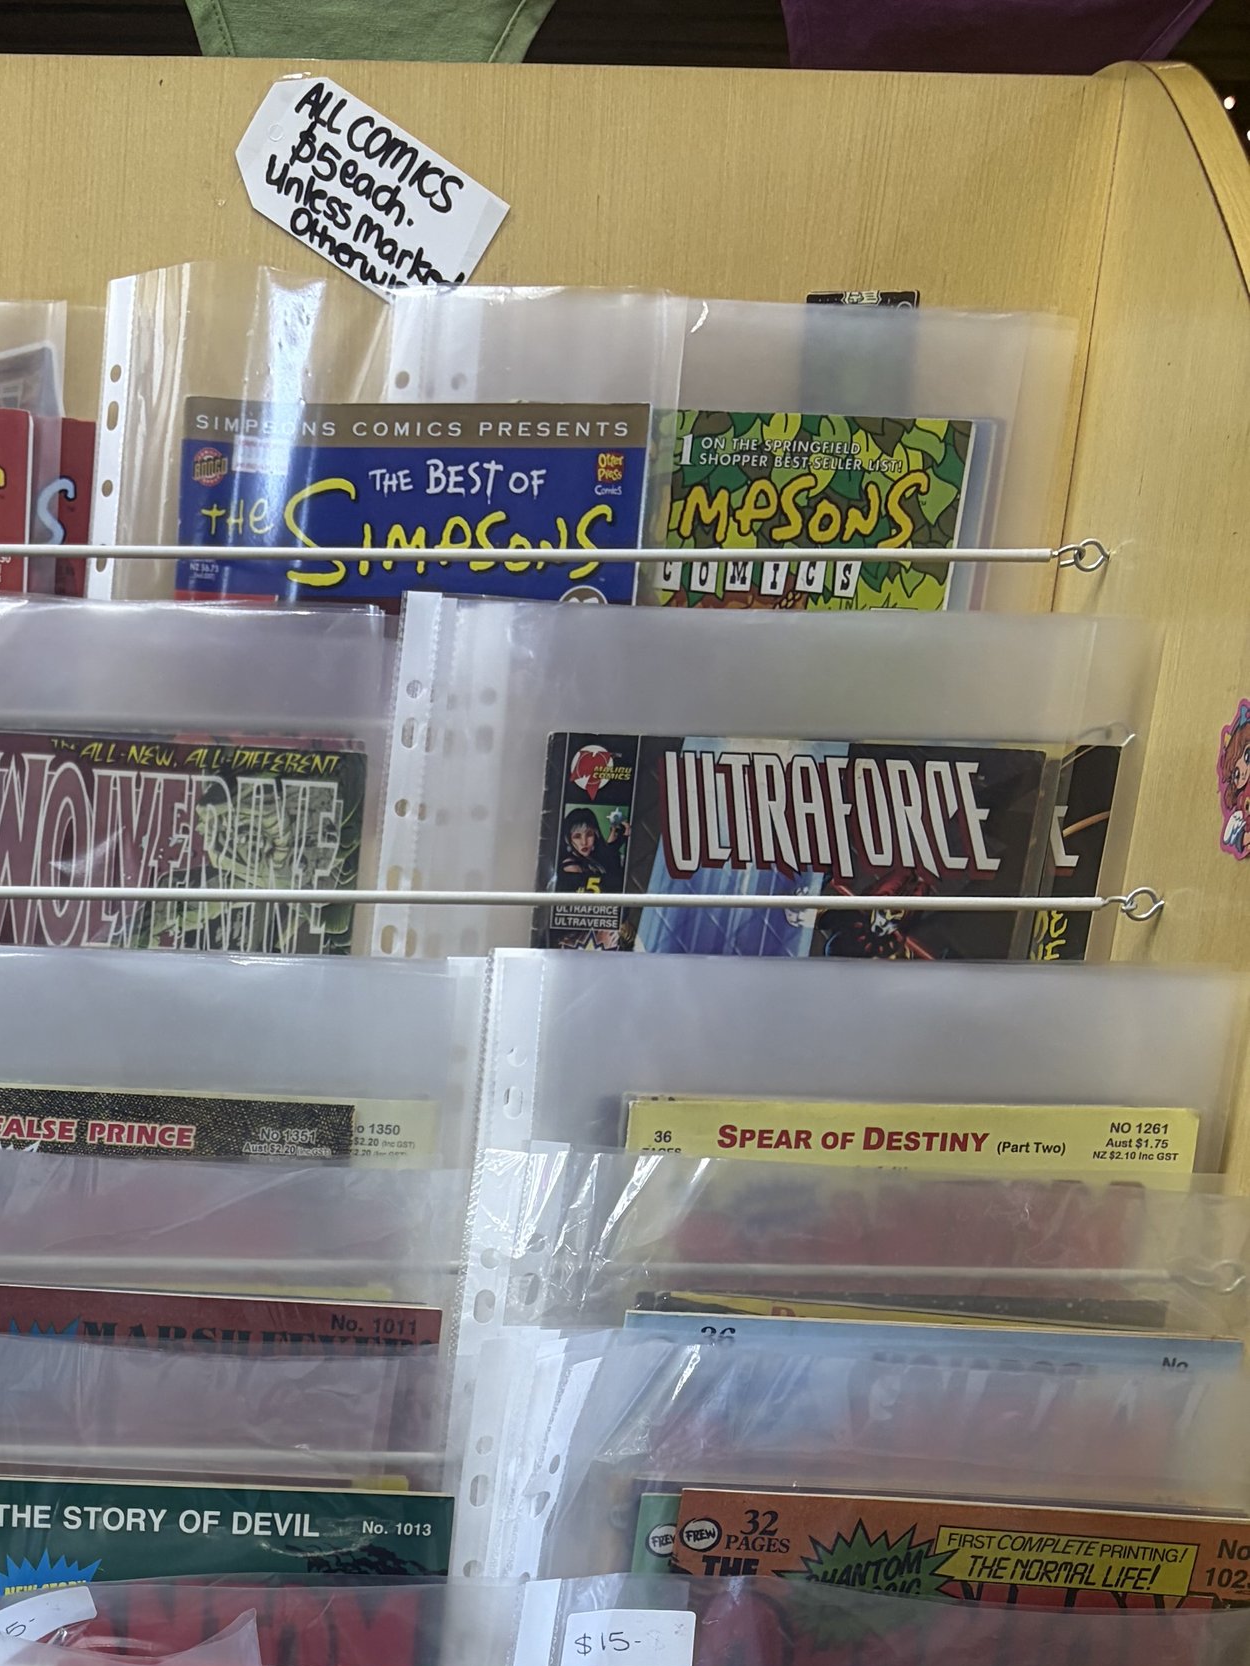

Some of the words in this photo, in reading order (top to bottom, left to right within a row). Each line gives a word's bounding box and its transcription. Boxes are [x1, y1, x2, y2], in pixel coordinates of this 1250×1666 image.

[294, 82, 348, 134] ALL
[290, 121, 342, 182] $5
[196, 413, 336, 438] SIMPSONS
[352, 421, 463, 438] COMICS
[478, 421, 630, 438] PRESENTS
[701, 437, 726, 450] ON
[732, 438, 758, 451] THE
[763, 439, 861, 455] SPRINGFIELD
[699, 453, 768, 467] SHOPPER
[774, 455, 861, 471] BEST-SELLER
[868, 458, 903, 474] LIST!
[368, 468, 414, 497] THE
[425, 458, 502, 504] BEST
[509, 467, 548, 500] OF
[284, 478, 612, 587] SIMPSONS
[184, 748, 340, 775] ALL-DIFFERENT
[663, 751, 1002, 880] ULTRAFORCE
[554, 917, 619, 928] ULTRAVERSE
[87, 1119, 195, 1149] PRINCE
[368, 1124, 400, 1135] 1350
[654, 1130, 672, 1143] 36
[717, 1123, 813, 1151] SPEAR
[862, 1125, 989, 1153] DESTINY
[996, 1140, 1030, 1157] (Part
[1033, 1141, 1066, 1157] Two)
[1109, 1121, 1132, 1134] NO
[1135, 1122, 1169, 1136] 1261
[1092, 1150, 1107, 1160] NZ
[1156, 1151, 1179, 1162] GST
[1105, 1137, 1131, 1149] Aust
[1134, 1137, 1169, 1150] $1.75
[372, 1317, 418, 1335] 1011
[63, 1506, 168, 1533] STORY
[179, 1509, 219, 1534] OF
[231, 1511, 320, 1538] DEVIL
[361, 1520, 390, 1535] No.
[395, 1522, 432, 1537] 1013
[740, 1509, 779, 1536] 32
[725, 1534, 790, 1553] PAGES
[947, 1533, 996, 1549] FIRST
[997, 1535, 1099, 1556] COMPLETE
[1100, 1545, 1189, 1563] PRINTING!
[968, 1555, 1010, 1579] THE
[1013, 1558, 1099, 1586] NORMAL
[1101, 1564, 1161, 1591] LIFE!
